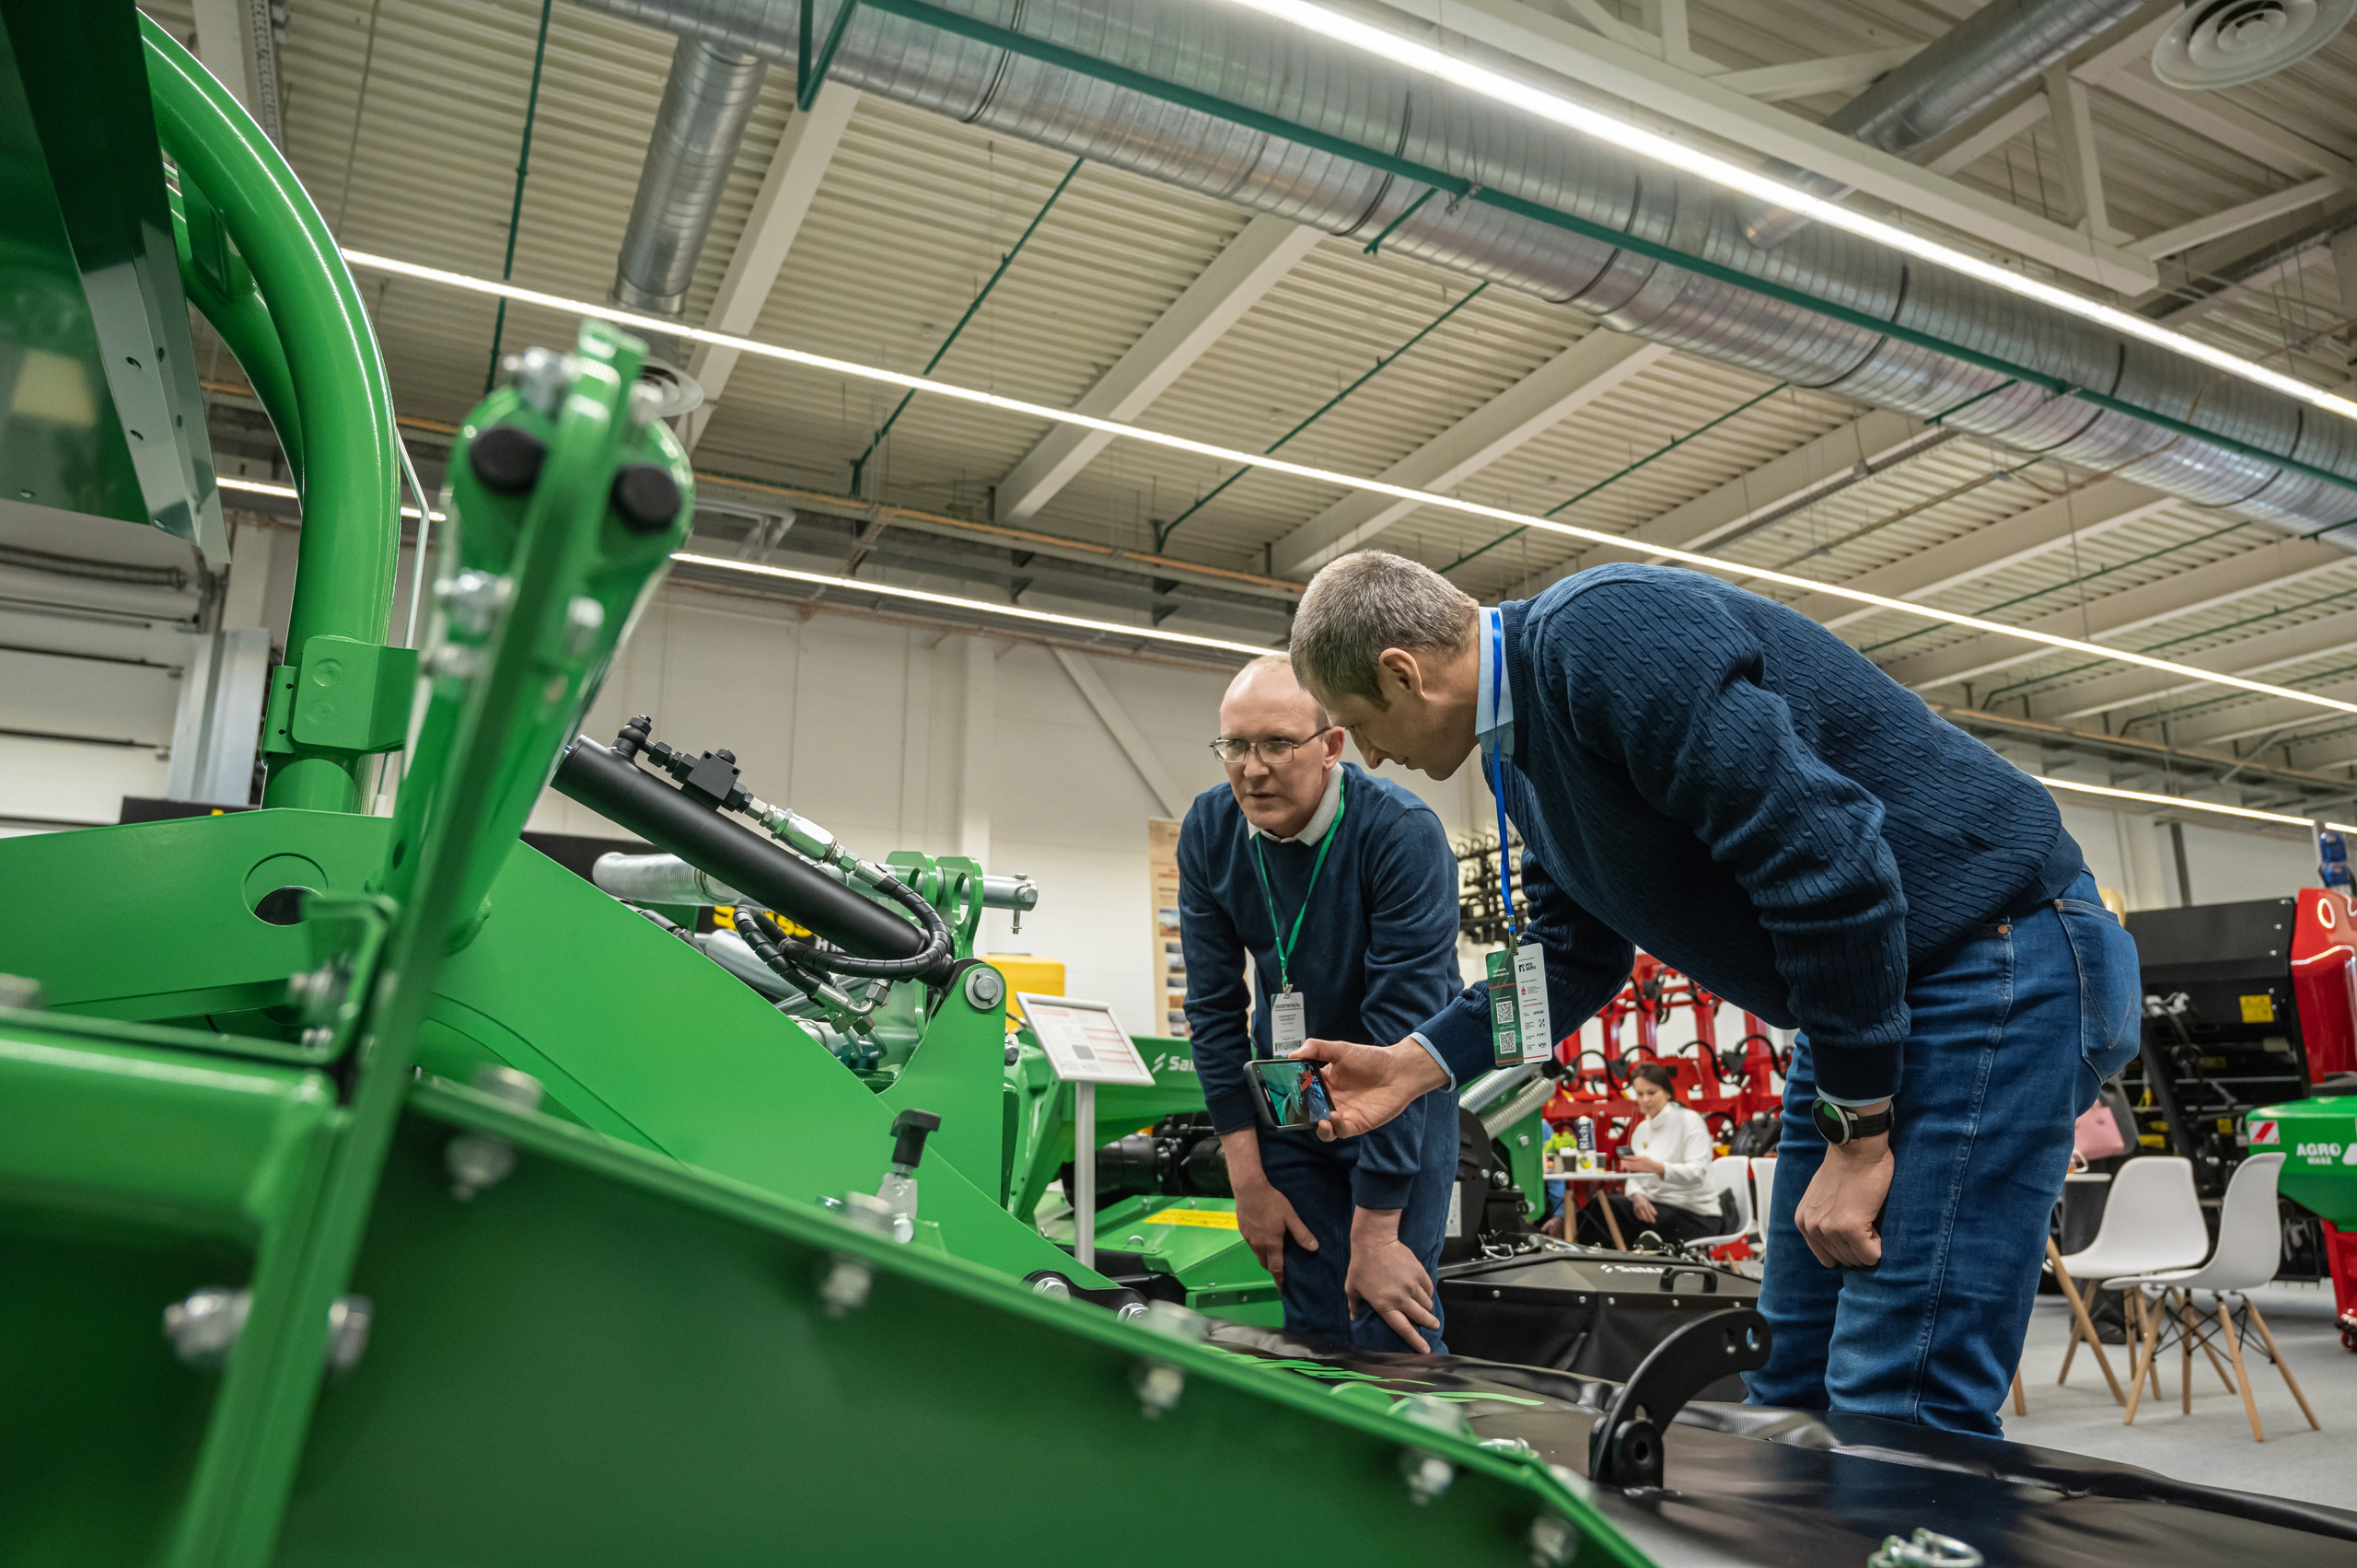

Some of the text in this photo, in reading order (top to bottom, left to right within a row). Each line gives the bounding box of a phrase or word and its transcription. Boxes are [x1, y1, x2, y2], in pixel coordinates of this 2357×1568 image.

[1167, 1055, 1197, 1072] Sa
[1578, 1125, 1590, 1150] Rich
[2296, 1143, 2342, 1157] AGRO
